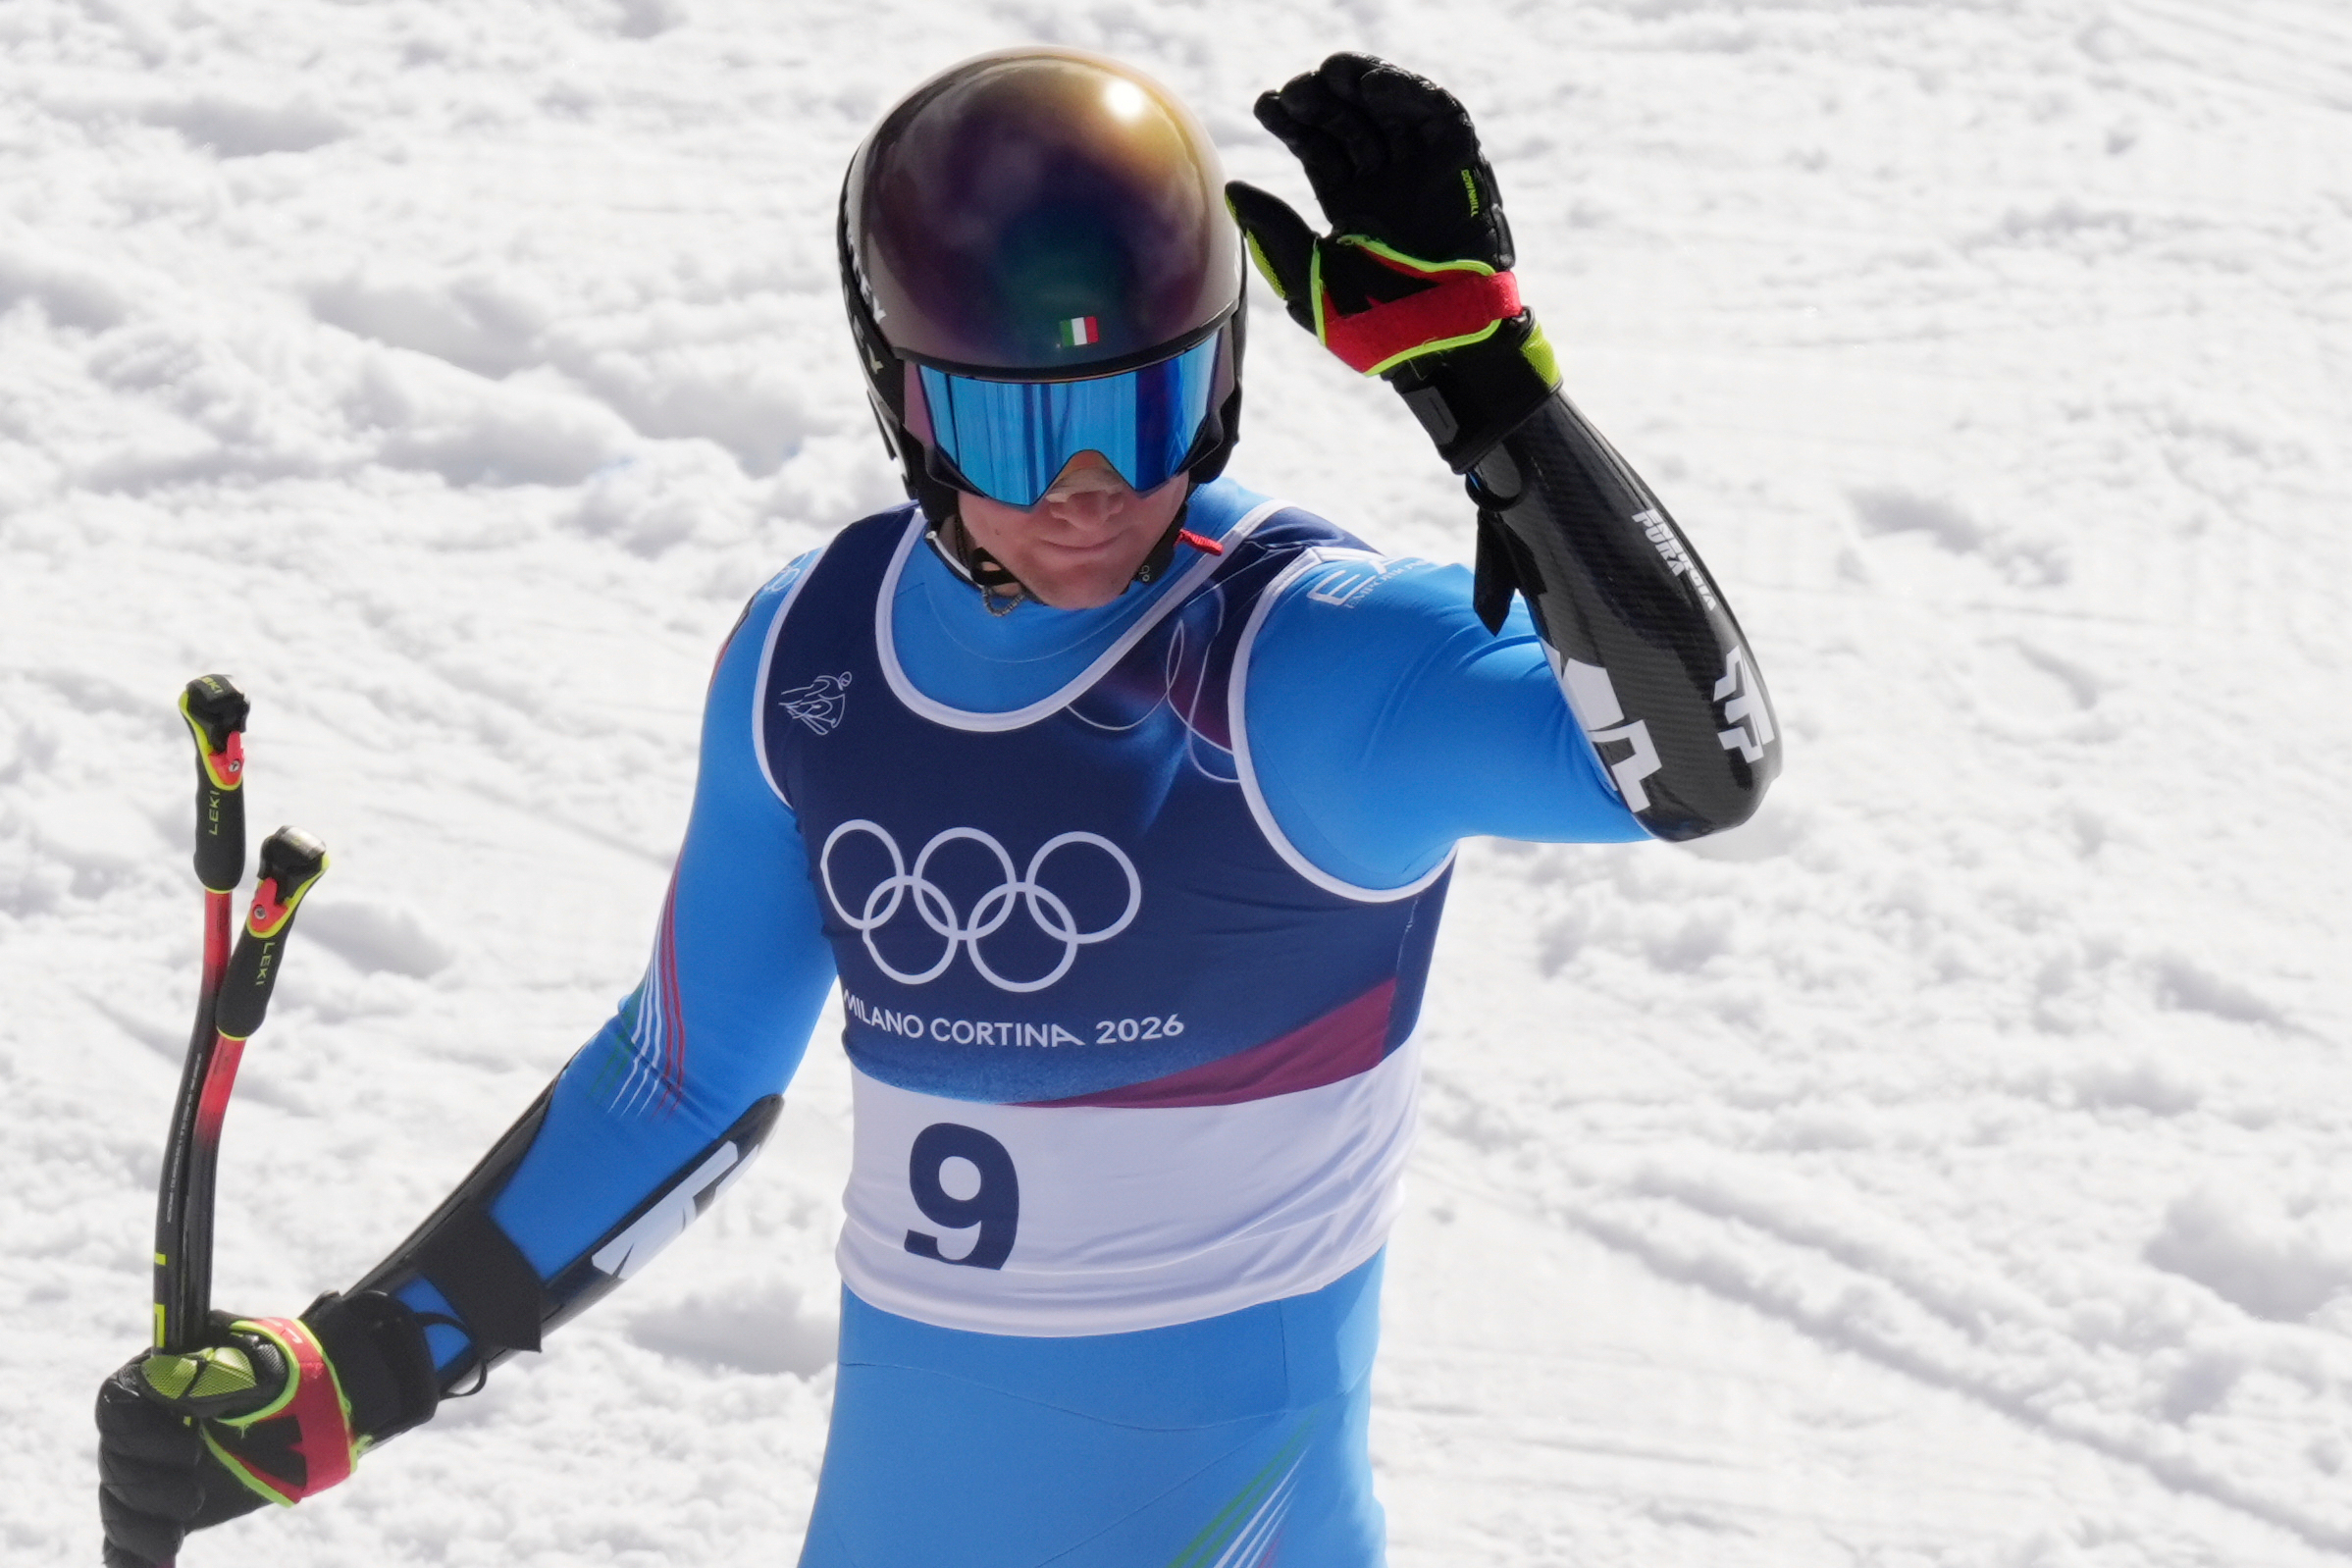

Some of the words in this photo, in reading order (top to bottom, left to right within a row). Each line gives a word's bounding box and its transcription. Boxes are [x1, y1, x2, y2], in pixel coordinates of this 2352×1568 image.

[1631, 511, 1685, 577] PURA
[209, 790, 221, 836] LEKI
[256, 942, 275, 985] LEKI
[843, 988, 924, 1038] MILANO
[929, 1018, 1086, 1047] CORTINA
[1095, 1014, 1184, 1044] 2026
[904, 1122, 1019, 1271] 9
